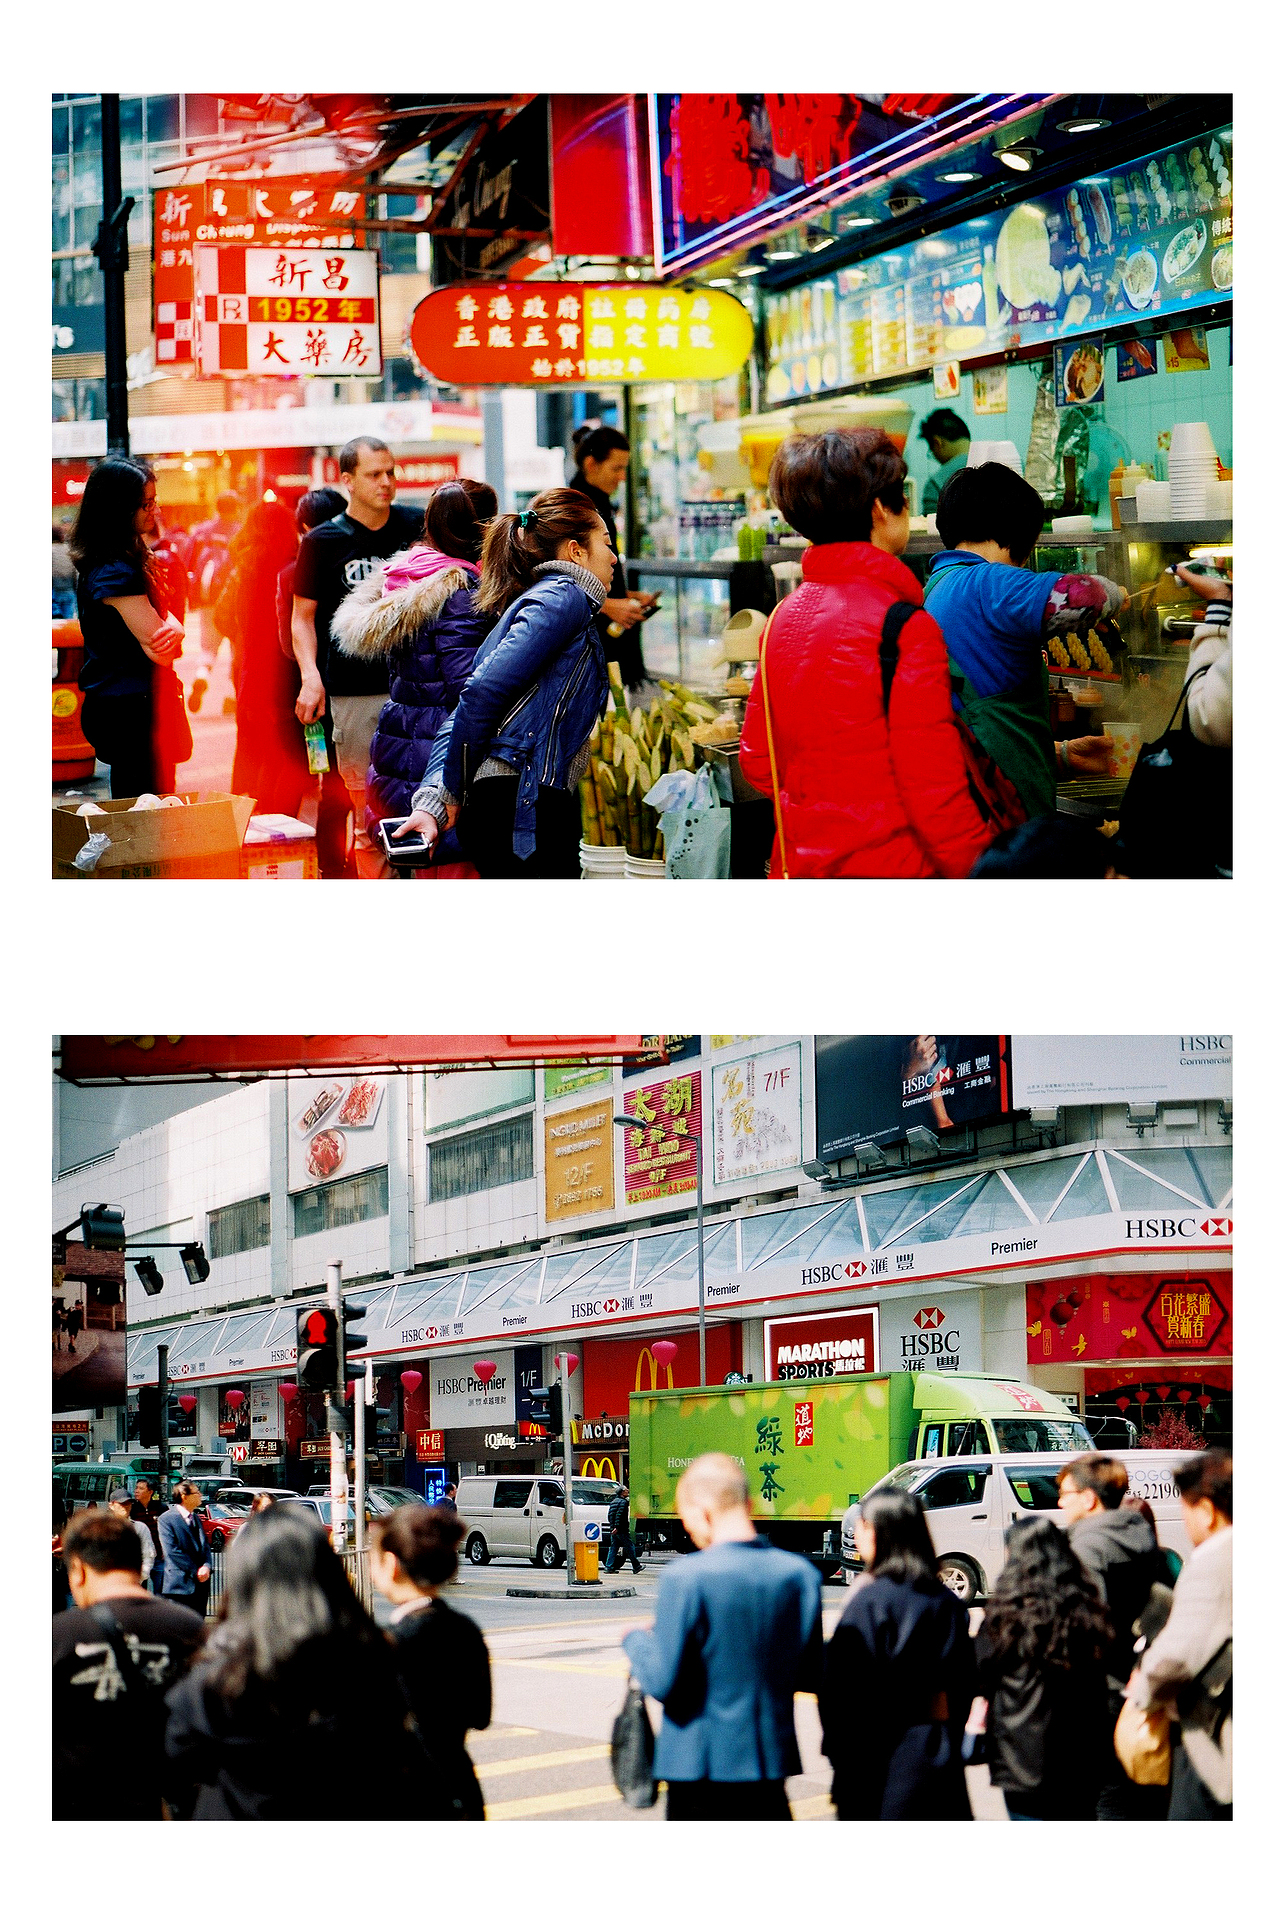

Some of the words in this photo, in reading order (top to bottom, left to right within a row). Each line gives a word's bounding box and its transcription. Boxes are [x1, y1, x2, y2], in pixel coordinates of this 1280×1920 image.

[161, 228, 190, 243] Sun
[269, 254, 351, 292] 新昌
[262, 328, 372, 368] 大藥房
[1165, 356, 1180, 369] $15
[1180, 1036, 1231, 1051] HSBC
[764, 1067, 791, 1092] 7/F
[902, 1072, 938, 1096] HSBC
[964, 1075, 992, 1090] 工商金融
[902, 1092, 934, 1109] Commercial
[933, 1087, 956, 1100] Banking
[564, 1162, 594, 1187] 12/F
[1125, 1218, 1197, 1239] HSBC
[990, 1237, 1039, 1256] Premier
[800, 1262, 844, 1286] HSBC
[706, 1282, 741, 1299] Premier
[571, 1301, 602, 1320] HSBC
[1161, 1293, 1211, 1316] 百花繁盛
[502, 1314, 528, 1328] Premier
[1167, 1314, 1205, 1339] 賀新春
[401, 1328, 426, 1344] HSBC
[901, 1329, 961, 1358] HSBC
[271, 1349, 290, 1363] HSBC
[777, 1338, 865, 1364] MARATHON
[228, 1357, 245, 1367] Premier
[777, 1361, 836, 1381] SPORTS
[437, 1378, 466, 1395] HSBC
[520, 1370, 537, 1387] 1/F
[795, 1403, 813, 1445] 道地
[420, 1433, 441, 1450] 中信
[754, 1416, 784, 1501] 綠茶
